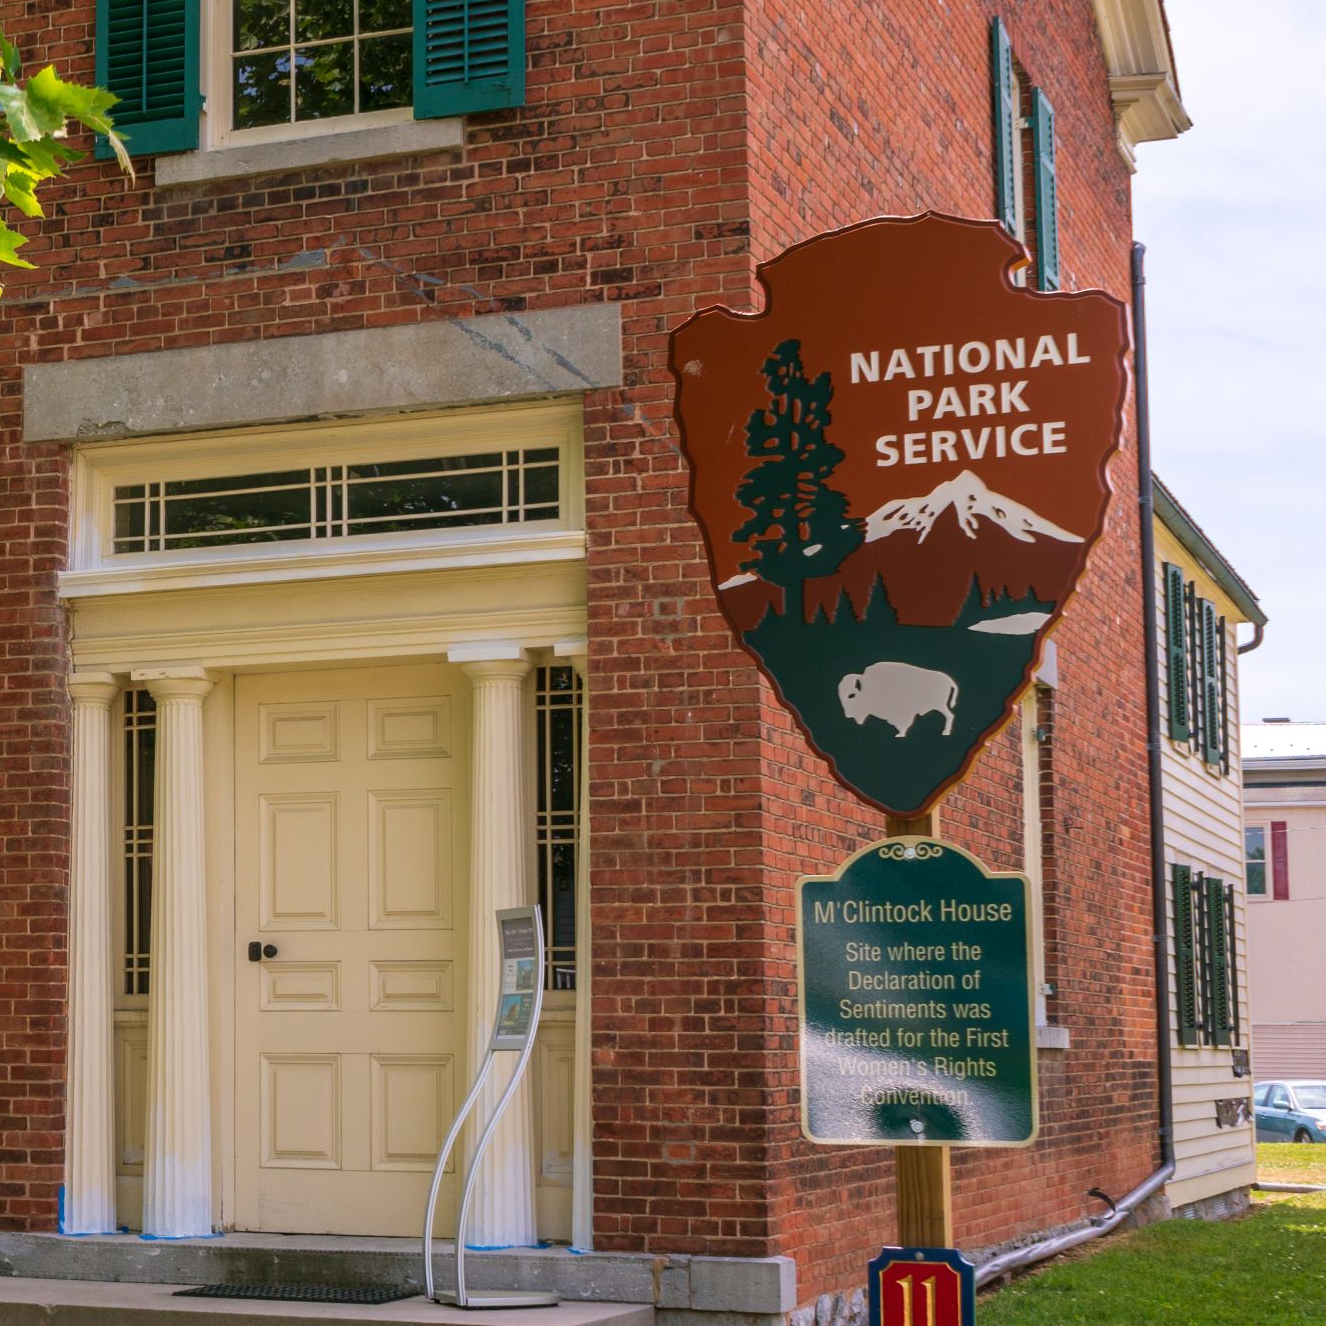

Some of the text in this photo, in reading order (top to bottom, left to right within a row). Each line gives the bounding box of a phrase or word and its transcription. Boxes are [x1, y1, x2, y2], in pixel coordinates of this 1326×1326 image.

[850, 332, 1091, 384] NATIONAL
[908, 380, 1031, 421] PARK
[876, 421, 1067, 467] SERVICE
[814, 899, 1012, 924] M'Clintock House
[845, 941, 982, 962] Site where the
[848, 970, 981, 990] Declaration of
[839, 999, 992, 1019] Sentiments was
[825, 1028, 1009, 1048] drafted for the First
[838, 1056, 997, 1081] Women's Rights
